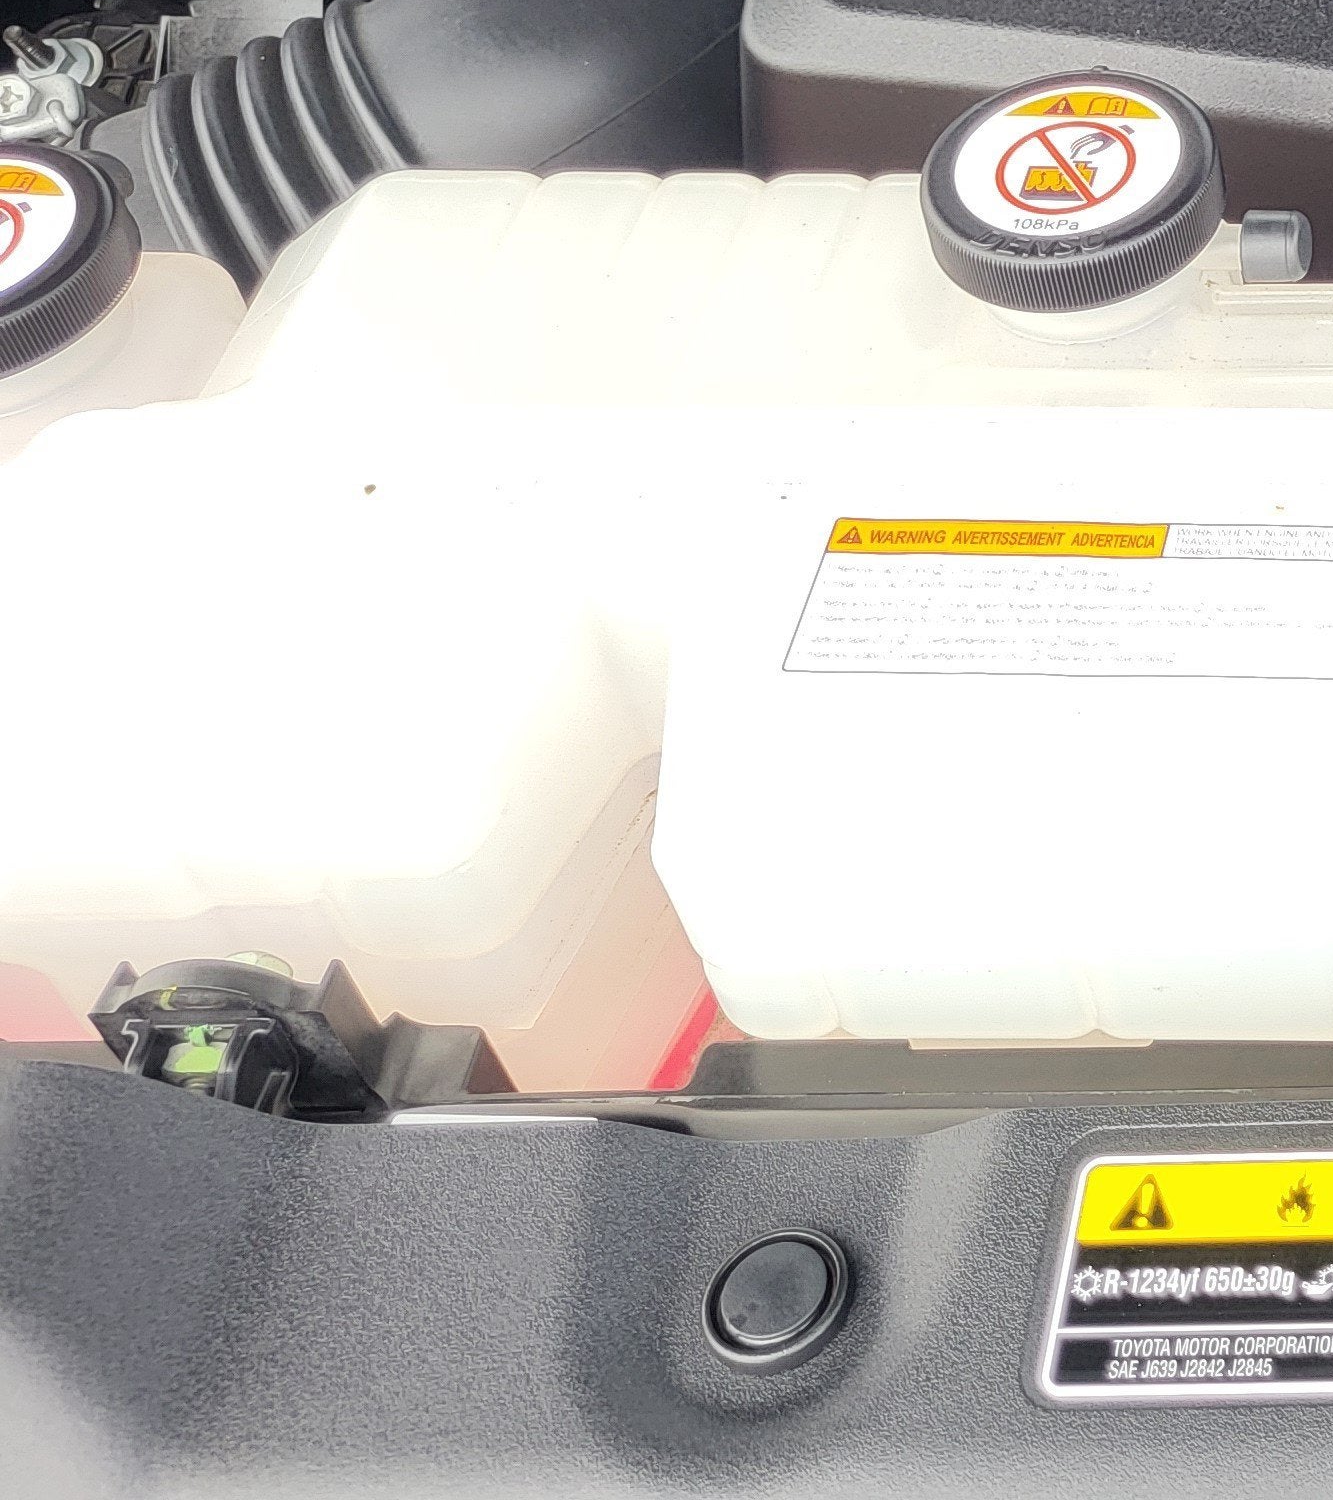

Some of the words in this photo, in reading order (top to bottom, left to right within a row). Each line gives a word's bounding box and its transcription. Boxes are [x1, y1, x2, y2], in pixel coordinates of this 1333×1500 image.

[1013, 218, 1080, 231] 108kPa
[969, 230, 1107, 259] DENSO
[869, 529, 947, 545] WARNING
[951, 531, 1066, 547] AVERTISSEMENT
[1071, 533, 1156, 549] ADVERTENCIA
[1102, 1267, 1200, 1298] R-1234yf
[1204, 1265, 1295, 1297] 650±30g
[1113, 1338, 1172, 1358] TOYOTA
[1175, 1337, 1230, 1356] MOTOR
[1108, 1359, 1138, 1379] SAE
[1141, 1358, 1177, 1379] J639
[1180, 1358, 1224, 1378] J2842
[1228, 1358, 1273, 1378] J2845
